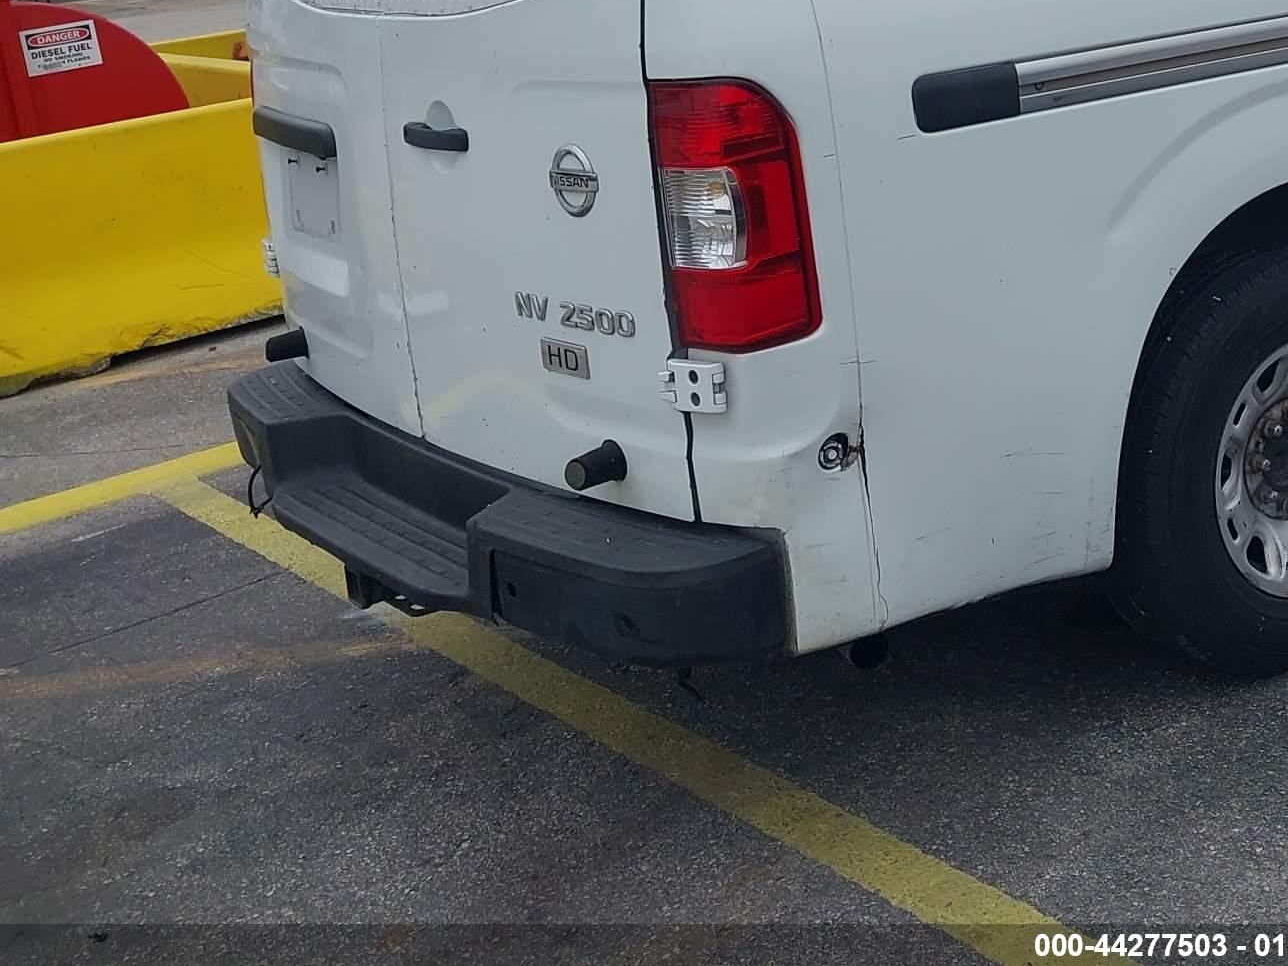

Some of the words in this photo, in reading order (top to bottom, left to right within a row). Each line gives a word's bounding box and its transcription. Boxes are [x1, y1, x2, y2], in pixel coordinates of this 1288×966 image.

[36, 30, 81, 45] DANGER
[31, 47, 66, 60] DIESEL
[68, 42, 93, 53] FUEL
[67, 55, 91, 64] FLAMES
[550, 174, 590, 189] NISSAN
[514, 291, 549, 322] NV
[559, 301, 636, 338] 2500
[547, 345, 579, 372] HD
